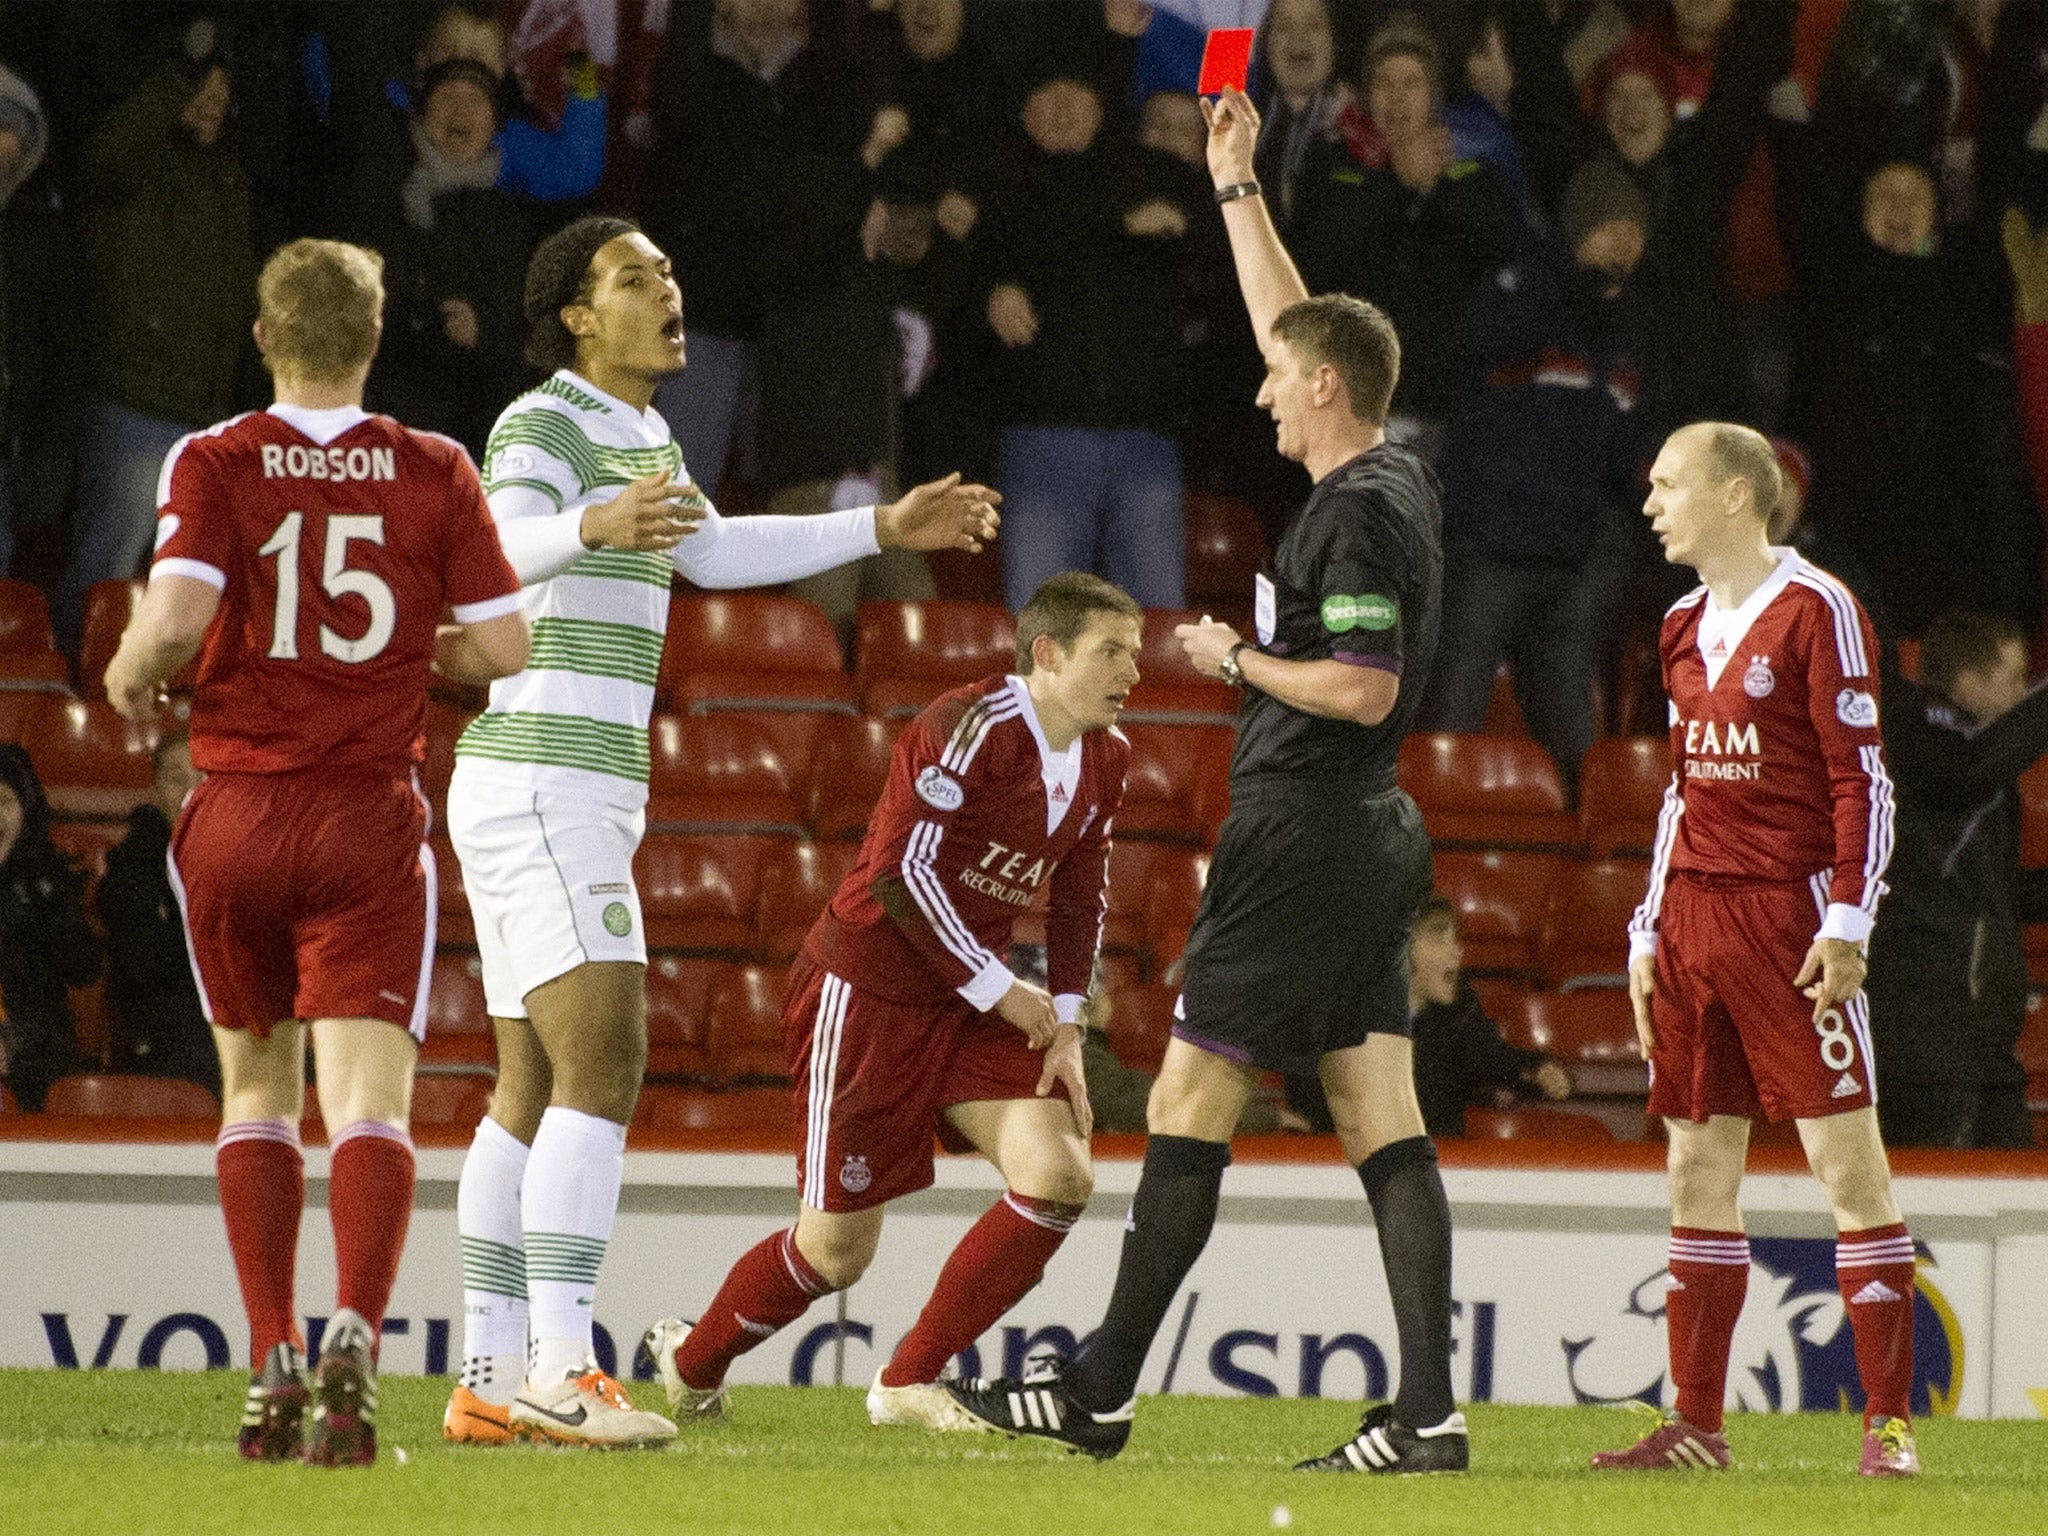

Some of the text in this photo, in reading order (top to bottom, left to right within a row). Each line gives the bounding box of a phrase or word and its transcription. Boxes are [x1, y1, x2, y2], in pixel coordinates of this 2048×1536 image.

[261, 444, 396, 482] ROBSON
[258, 511, 396, 664] 15
[1680, 719, 1761, 755] EAM
[1815, 1008, 1854, 1071] 8
